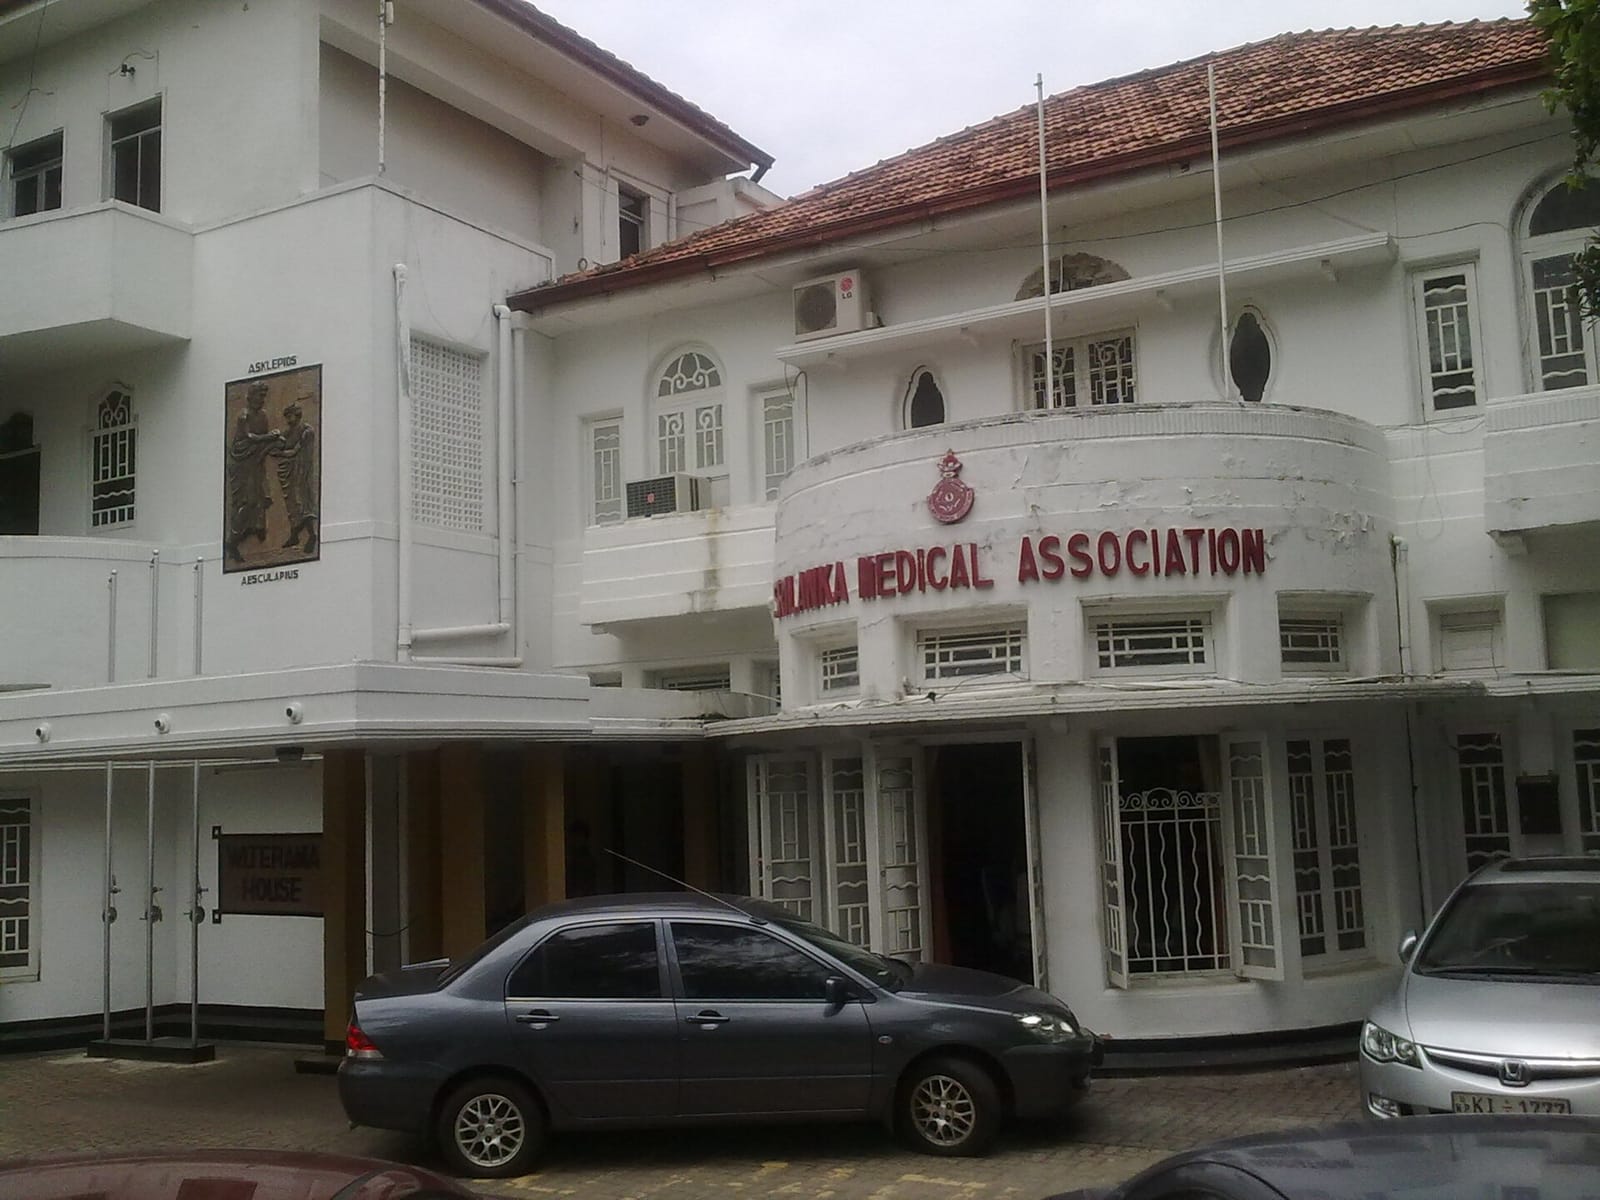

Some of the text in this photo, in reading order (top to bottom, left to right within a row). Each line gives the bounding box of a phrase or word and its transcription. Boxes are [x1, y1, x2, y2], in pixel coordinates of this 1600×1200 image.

[841, 291, 853, 300] LG
[247, 355, 297, 374] ASKLEPIOS
[857, 543, 994, 601] MEDICAL
[1018, 528, 1265, 584] ASSOCIATION
[241, 877, 303, 902] HOUSE
